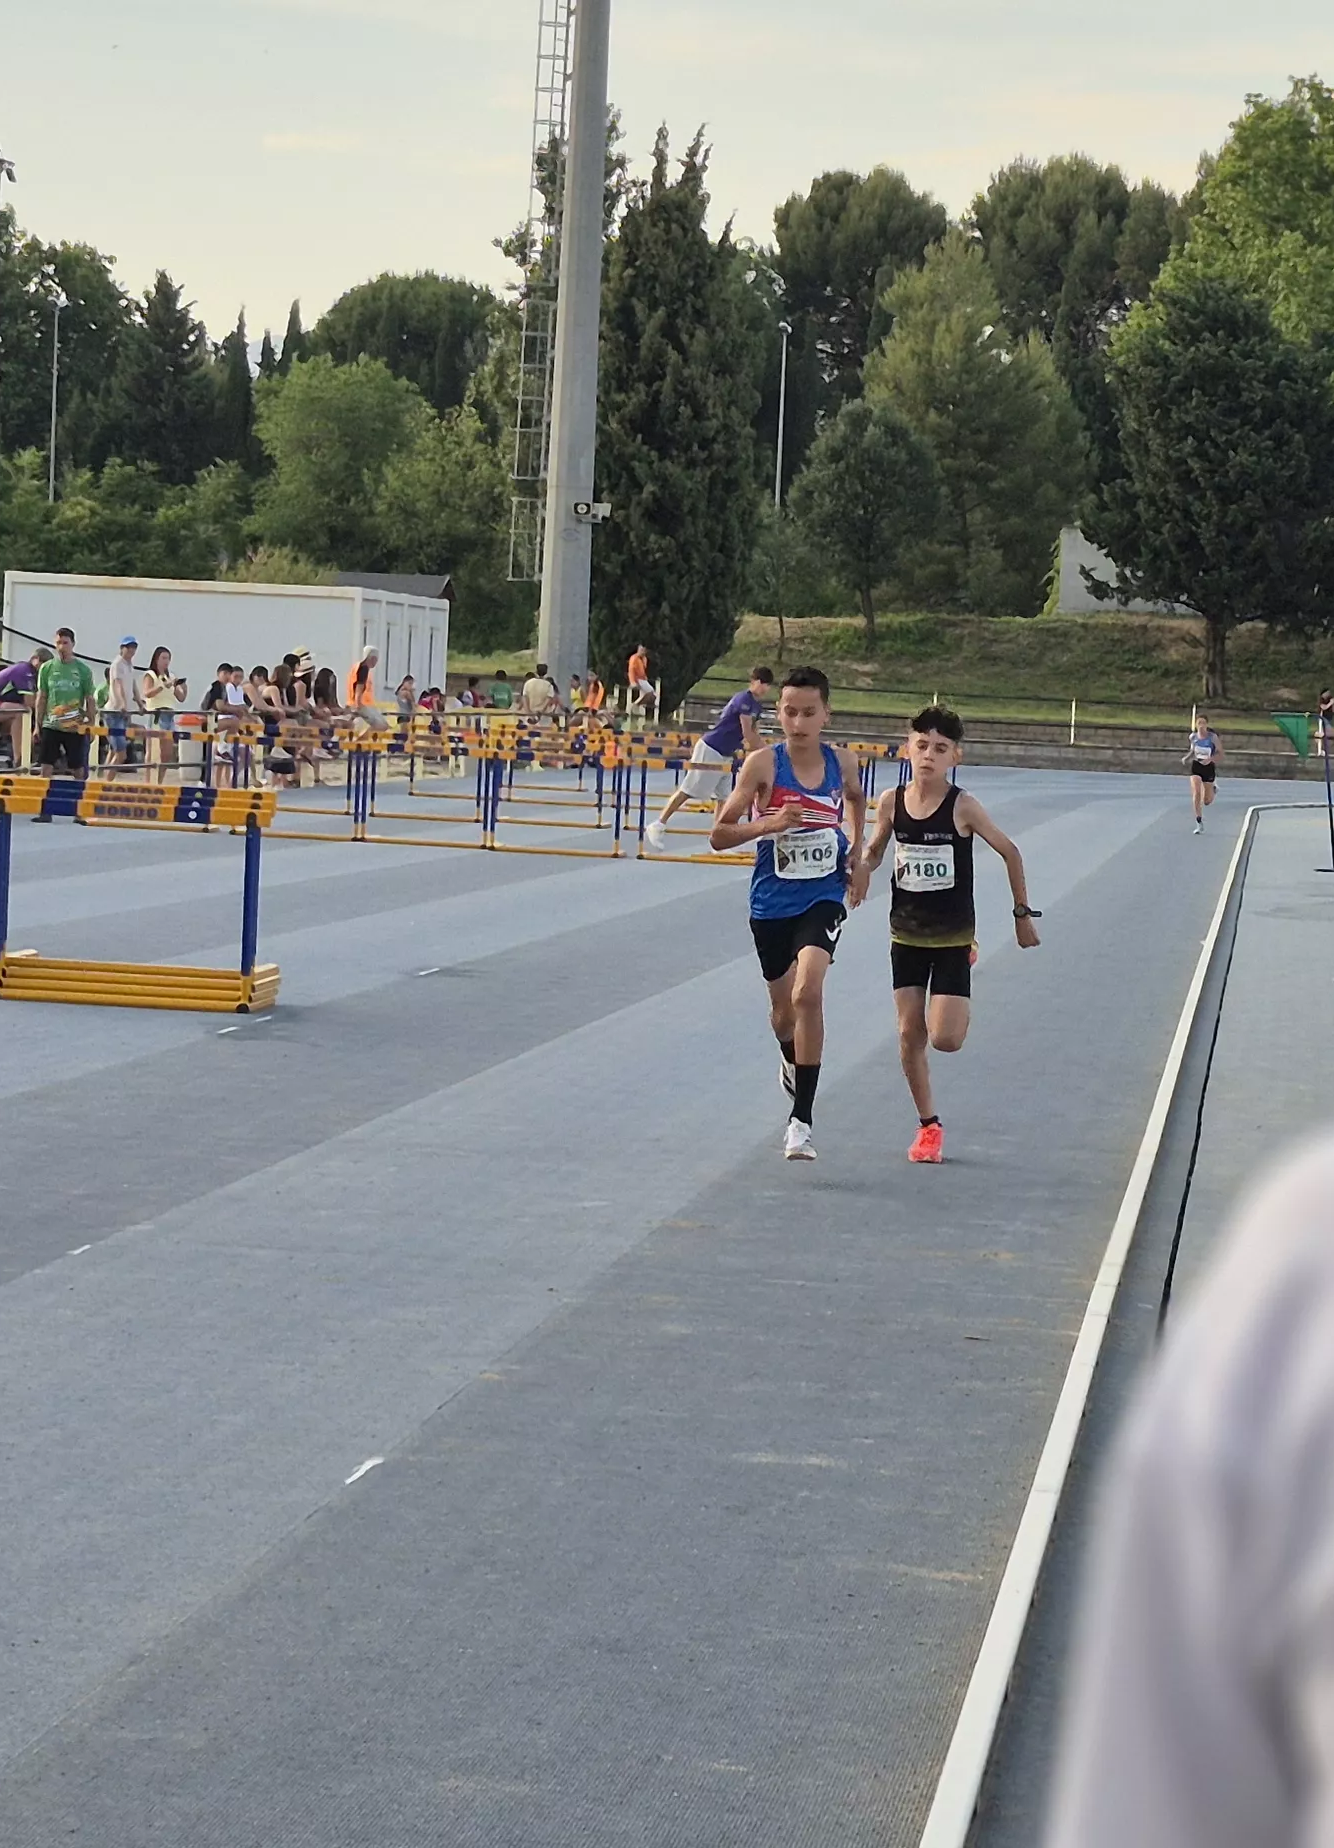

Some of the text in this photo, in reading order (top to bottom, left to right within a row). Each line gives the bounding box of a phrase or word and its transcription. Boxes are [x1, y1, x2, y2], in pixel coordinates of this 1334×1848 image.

[94, 806, 158, 819] MONDO
[789, 845, 833, 863] 1106
[904, 862, 947, 877] 1180
